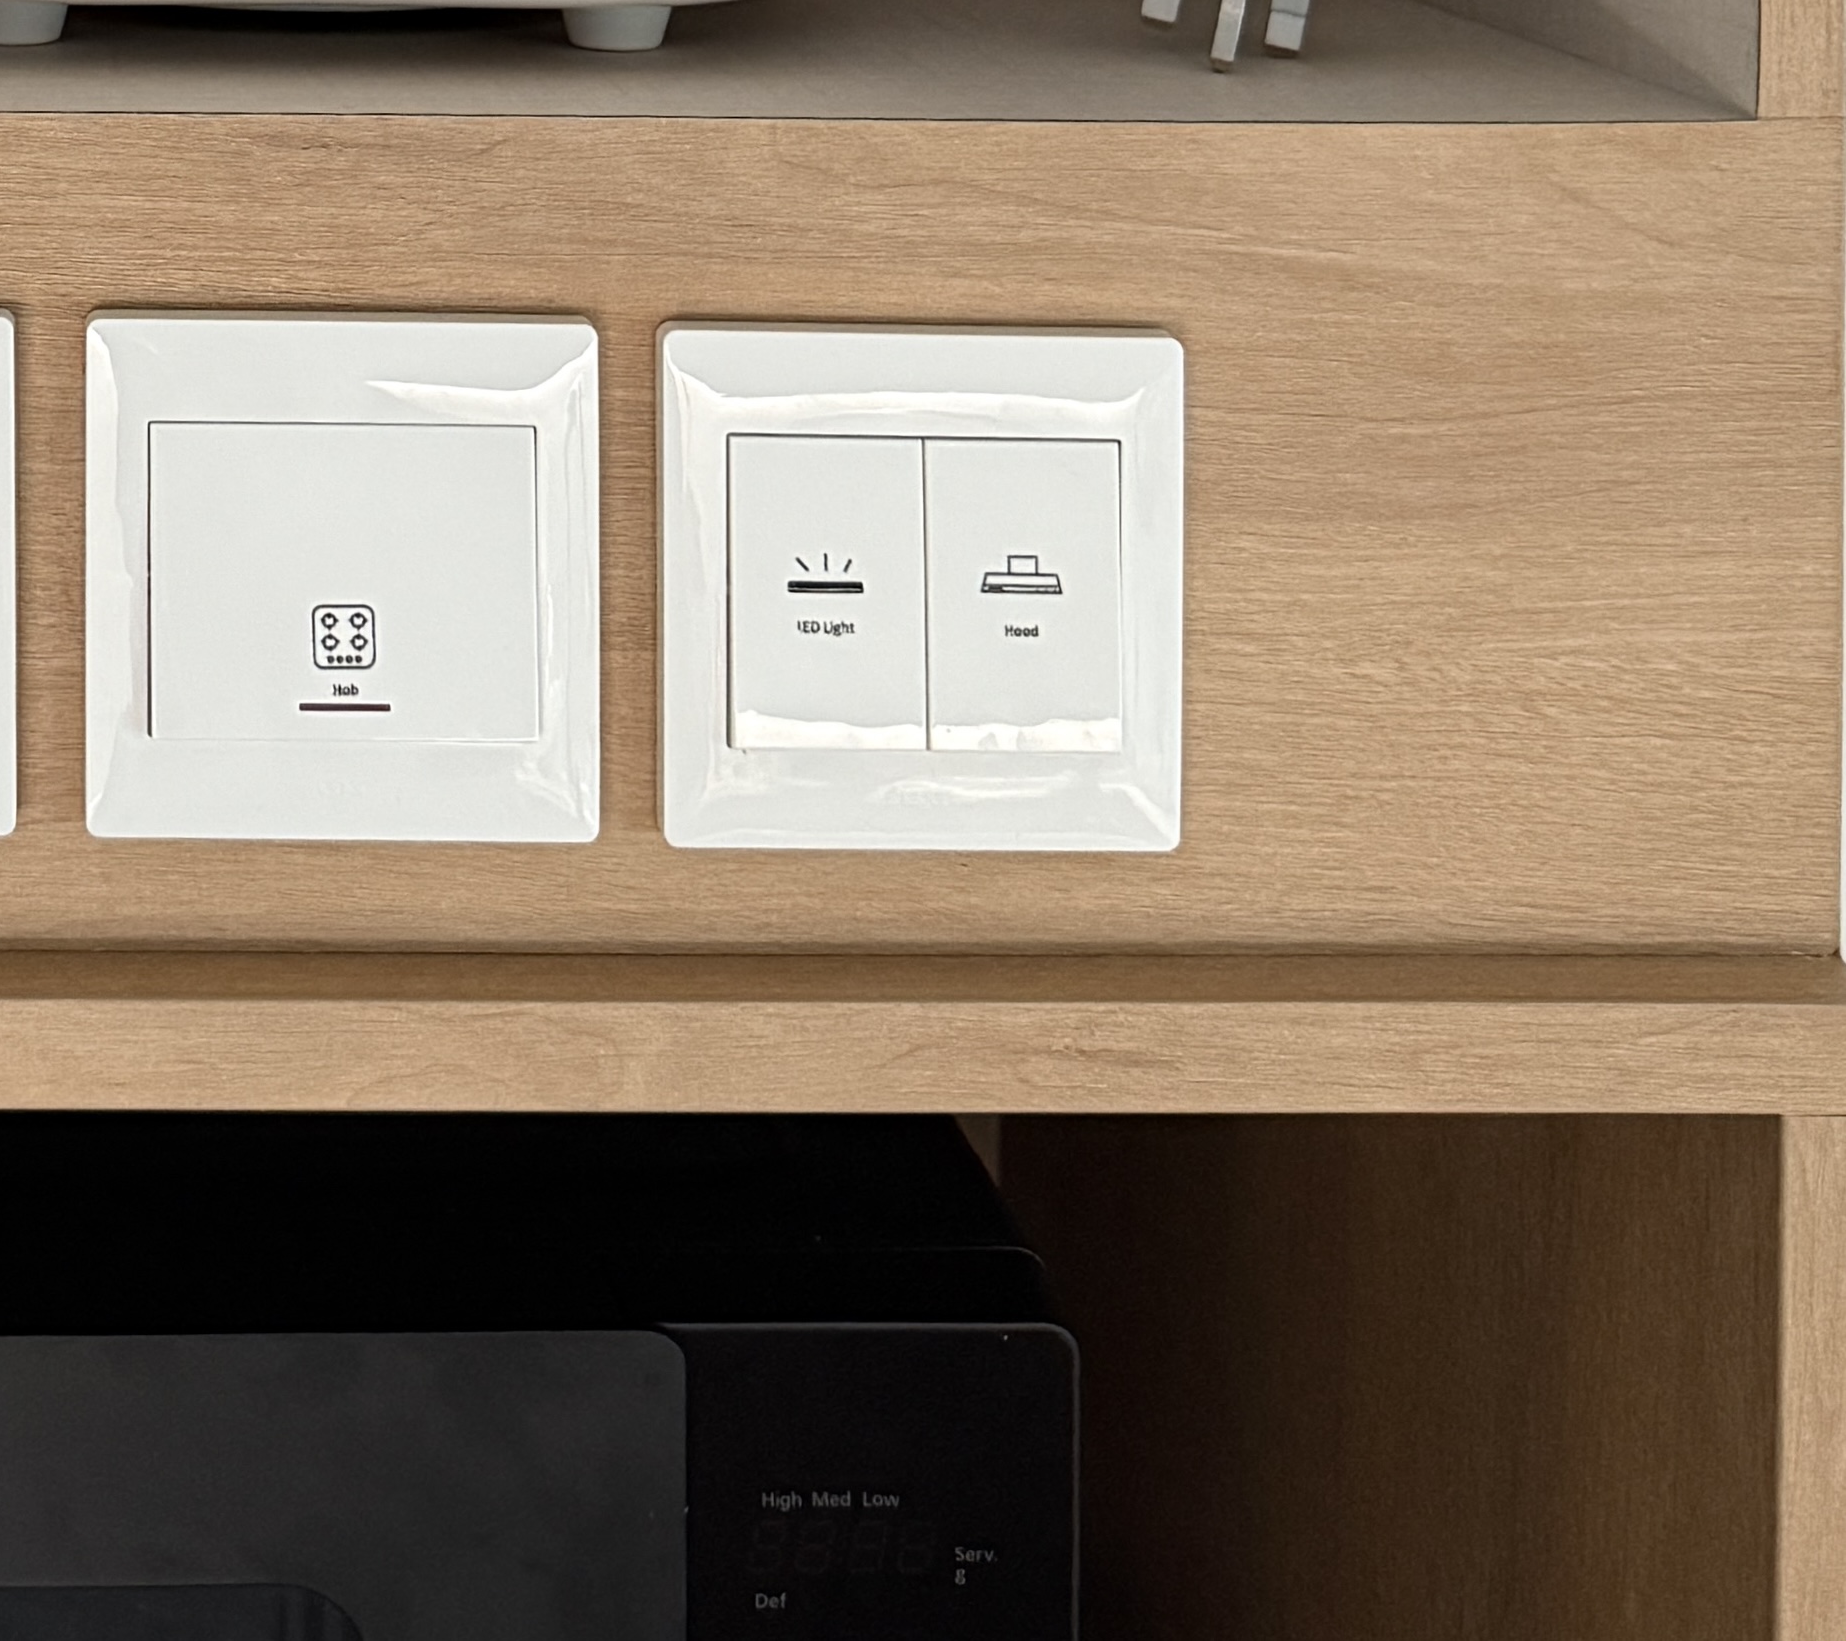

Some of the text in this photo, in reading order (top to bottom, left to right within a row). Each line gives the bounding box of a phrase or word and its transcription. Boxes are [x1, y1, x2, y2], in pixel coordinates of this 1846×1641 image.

[1004, 624, 1039, 638] Hood
[331, 683, 359, 697] Hob
[761, 1490, 900, 1513] High Med Low
[754, 1592, 787, 1610] Def
